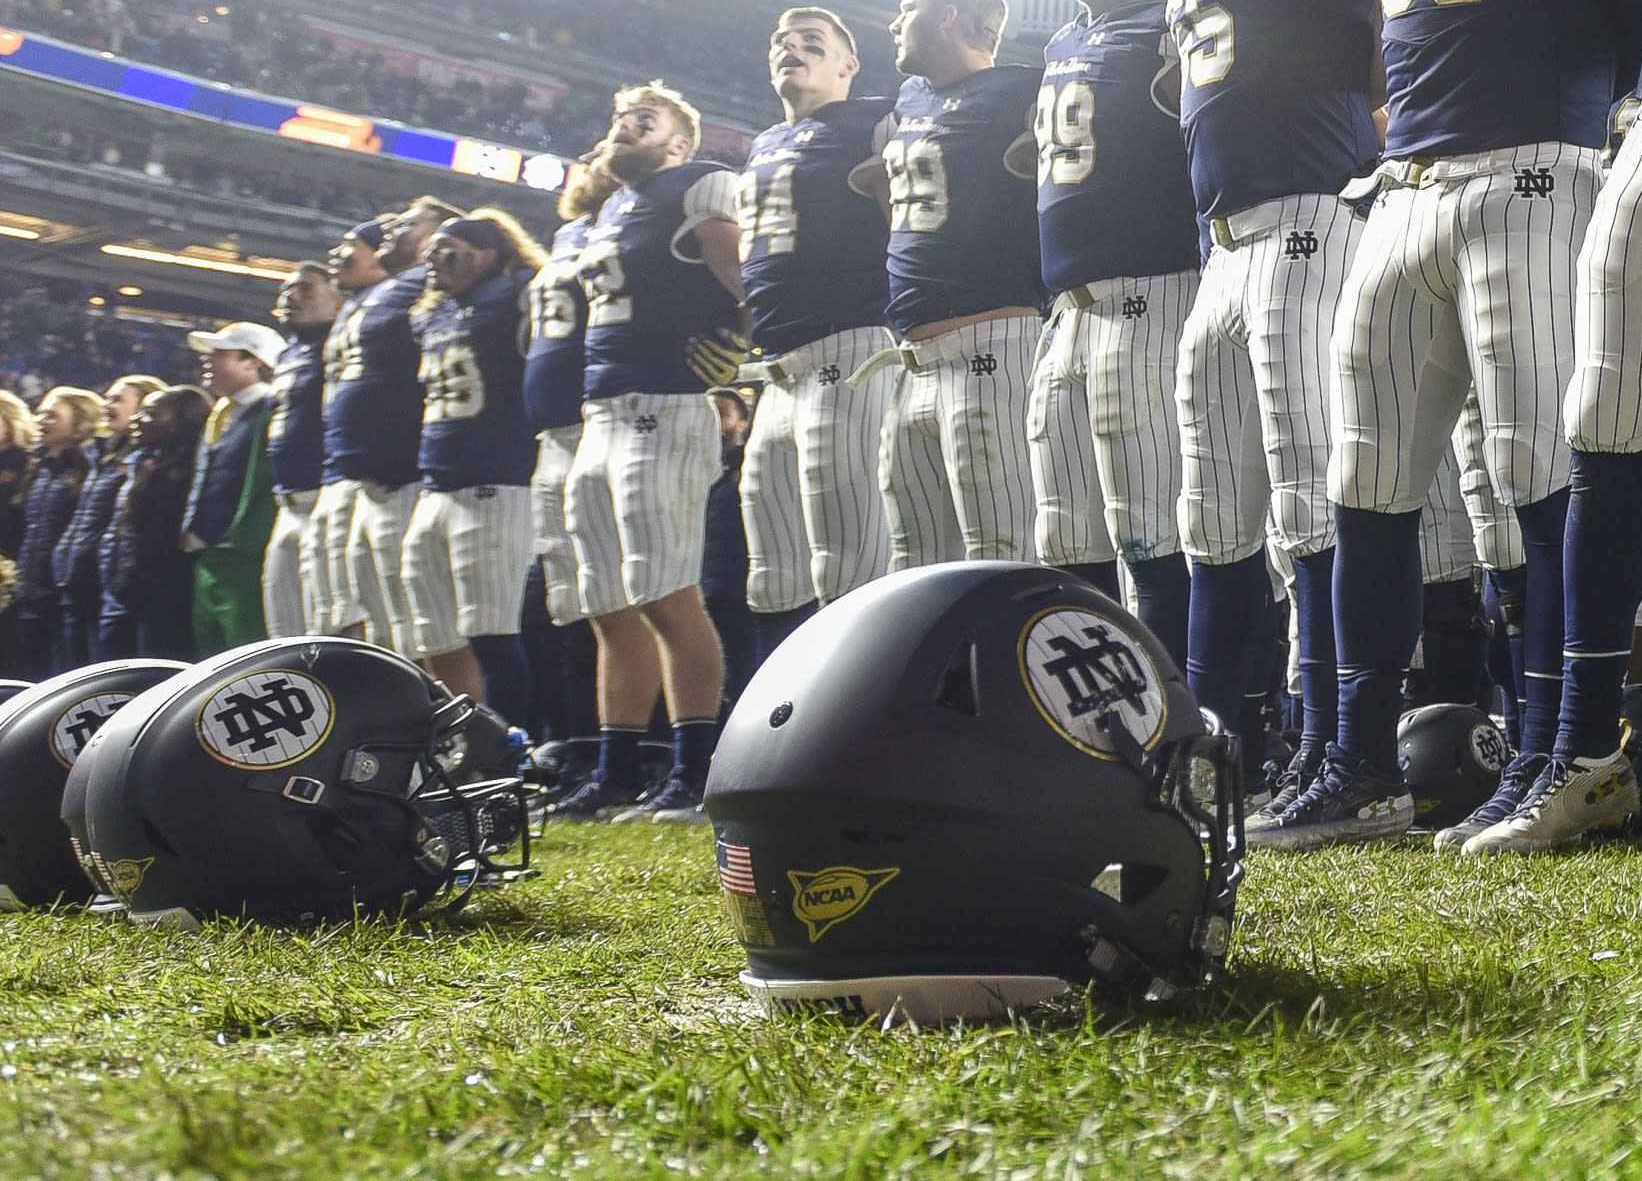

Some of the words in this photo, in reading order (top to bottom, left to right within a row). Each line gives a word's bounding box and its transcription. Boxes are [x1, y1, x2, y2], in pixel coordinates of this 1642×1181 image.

[1514, 166, 1555, 200] ND
[1285, 229, 1318, 261] ND
[1120, 295, 1147, 319] ND
[214, 678, 316, 753] ND
[804, 886, 856, 908] NCAA
